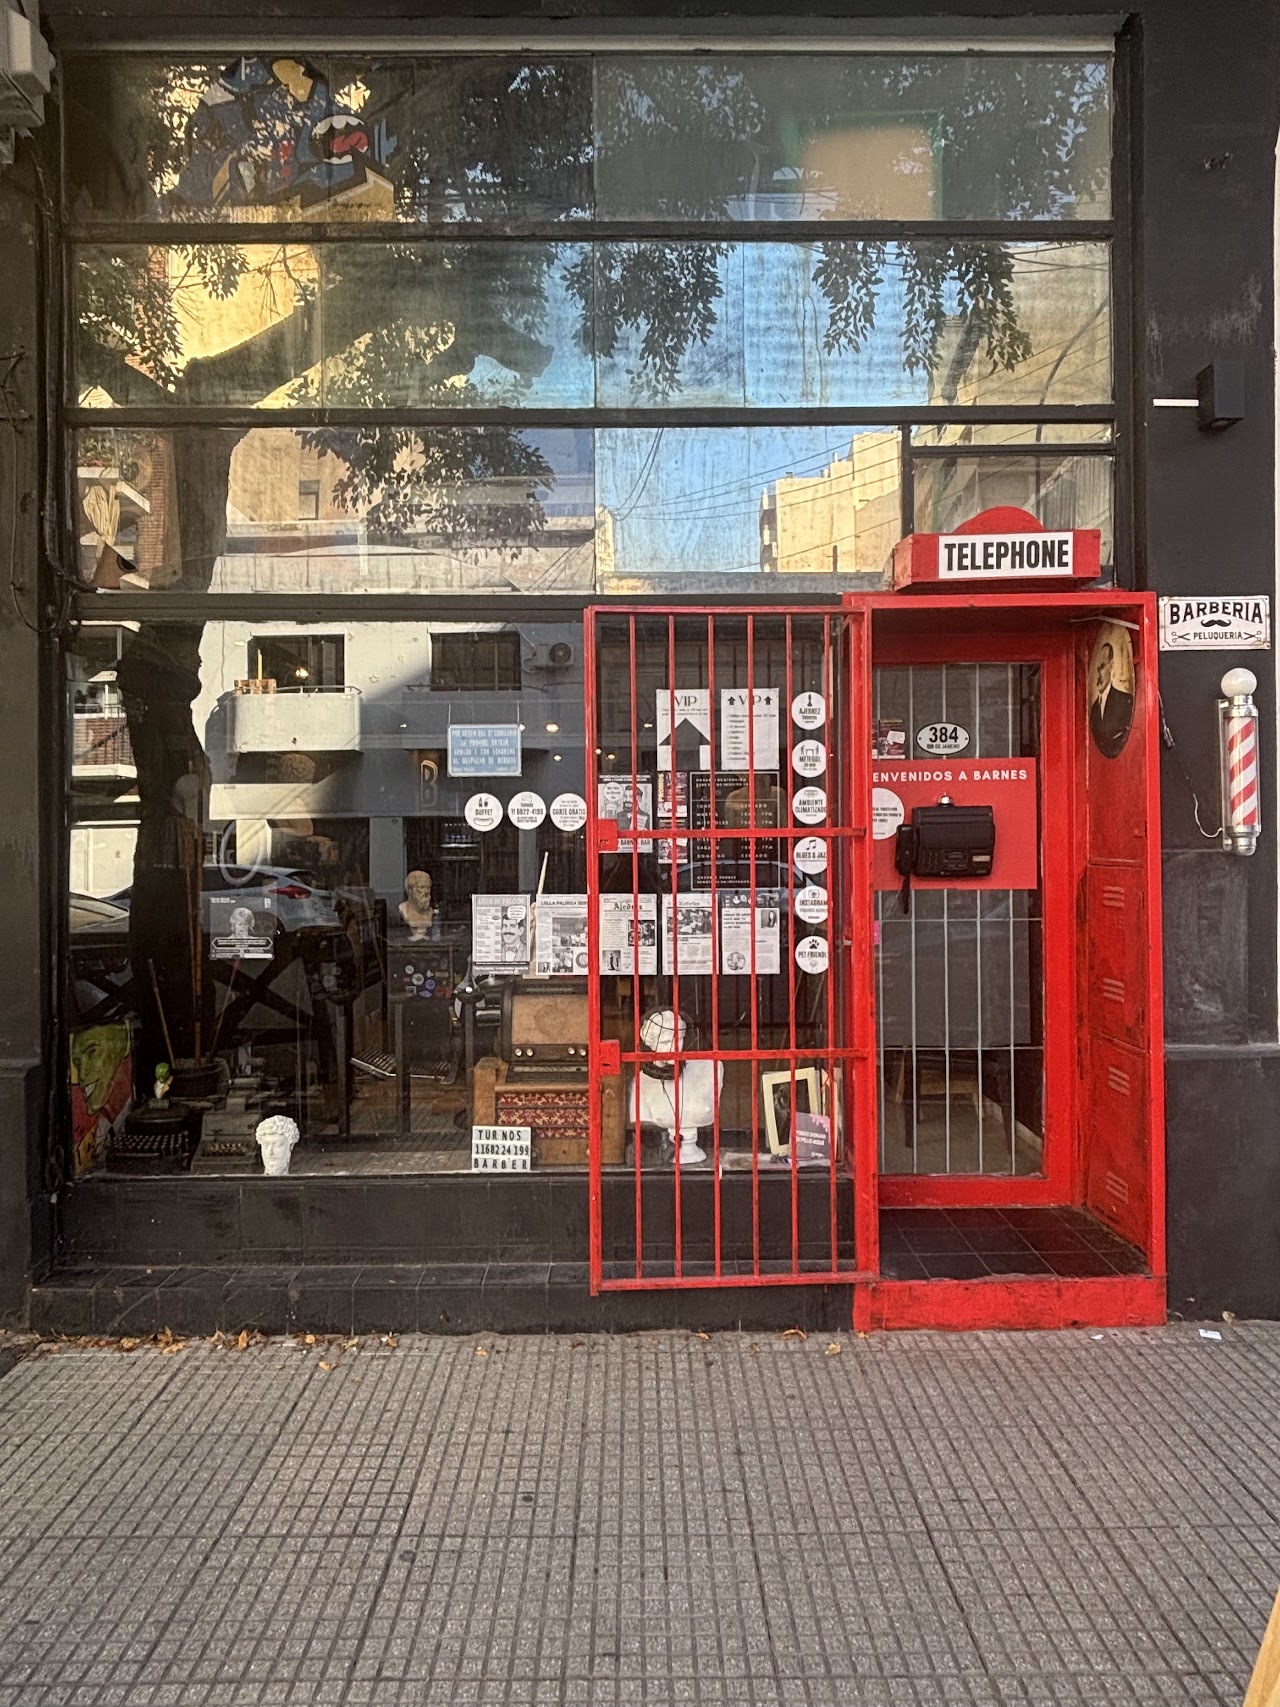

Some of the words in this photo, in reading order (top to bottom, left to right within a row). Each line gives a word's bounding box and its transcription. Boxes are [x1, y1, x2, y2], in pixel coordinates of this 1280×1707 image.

[944, 539, 1069, 571] TELEPHONE
[1169, 601, 1264, 625] BARBERIA
[1193, 631, 1243, 640] PELUQUERIA
[674, 695, 698, 707] VIP
[738, 695, 762, 706] VP
[799, 707, 821, 715] AJEDREZ
[929, 726, 959, 743] 384
[799, 755, 821, 763] METEGOL
[873, 771, 953, 783] ENVENIDOS
[958, 771, 968, 781] A
[973, 769, 1028, 781] BARNES
[475, 808, 493, 816] BUFFET
[552, 808, 568, 816] CORTE
[568, 808, 586, 816] GRATIS
[613, 902, 643, 911] Ajedrz
[473, 1158, 528, 1170] BARBER
